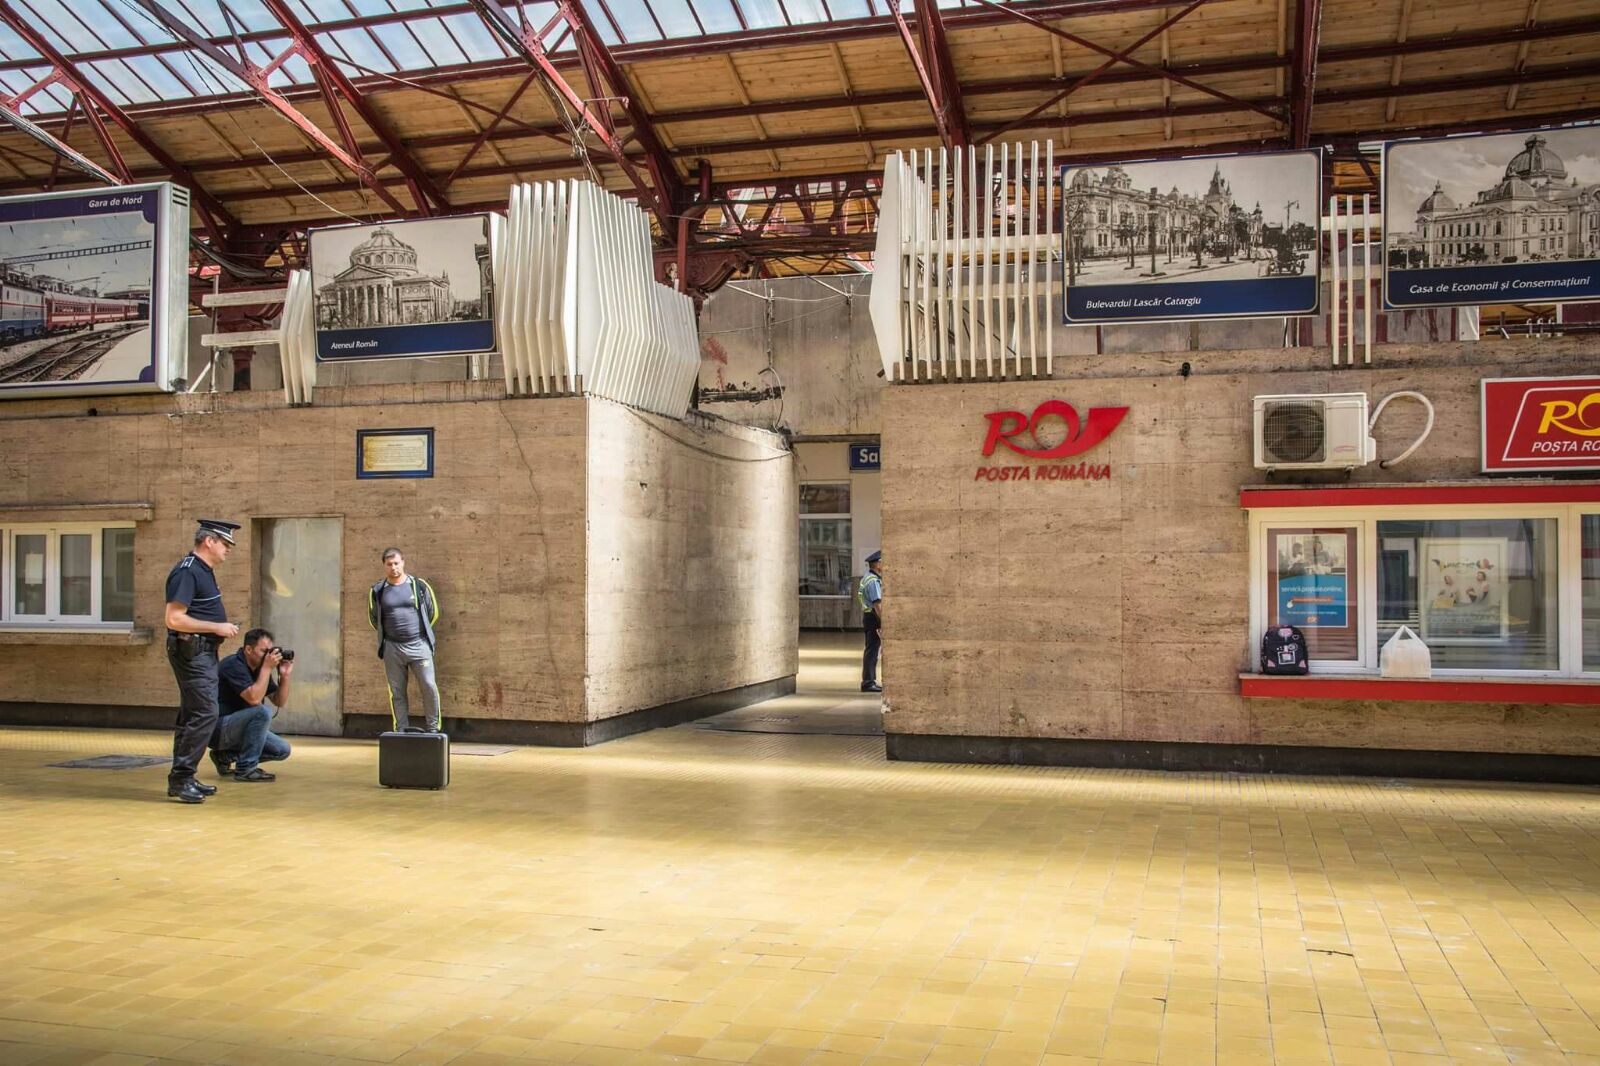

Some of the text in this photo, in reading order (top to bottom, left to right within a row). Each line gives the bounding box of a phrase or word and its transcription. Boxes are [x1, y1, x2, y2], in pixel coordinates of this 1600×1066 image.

[88, 195, 143, 208] Gara de Nord
[1409, 284, 1433, 294] Casa
[1436, 283, 1449, 293] de
[1452, 281, 1498, 292] Economii
[1086, 296, 1202, 309] Bulevardul Lascăr Catargiu
[330, 341, 355, 350] Ateneul
[860, 448, 880, 463] Sa
